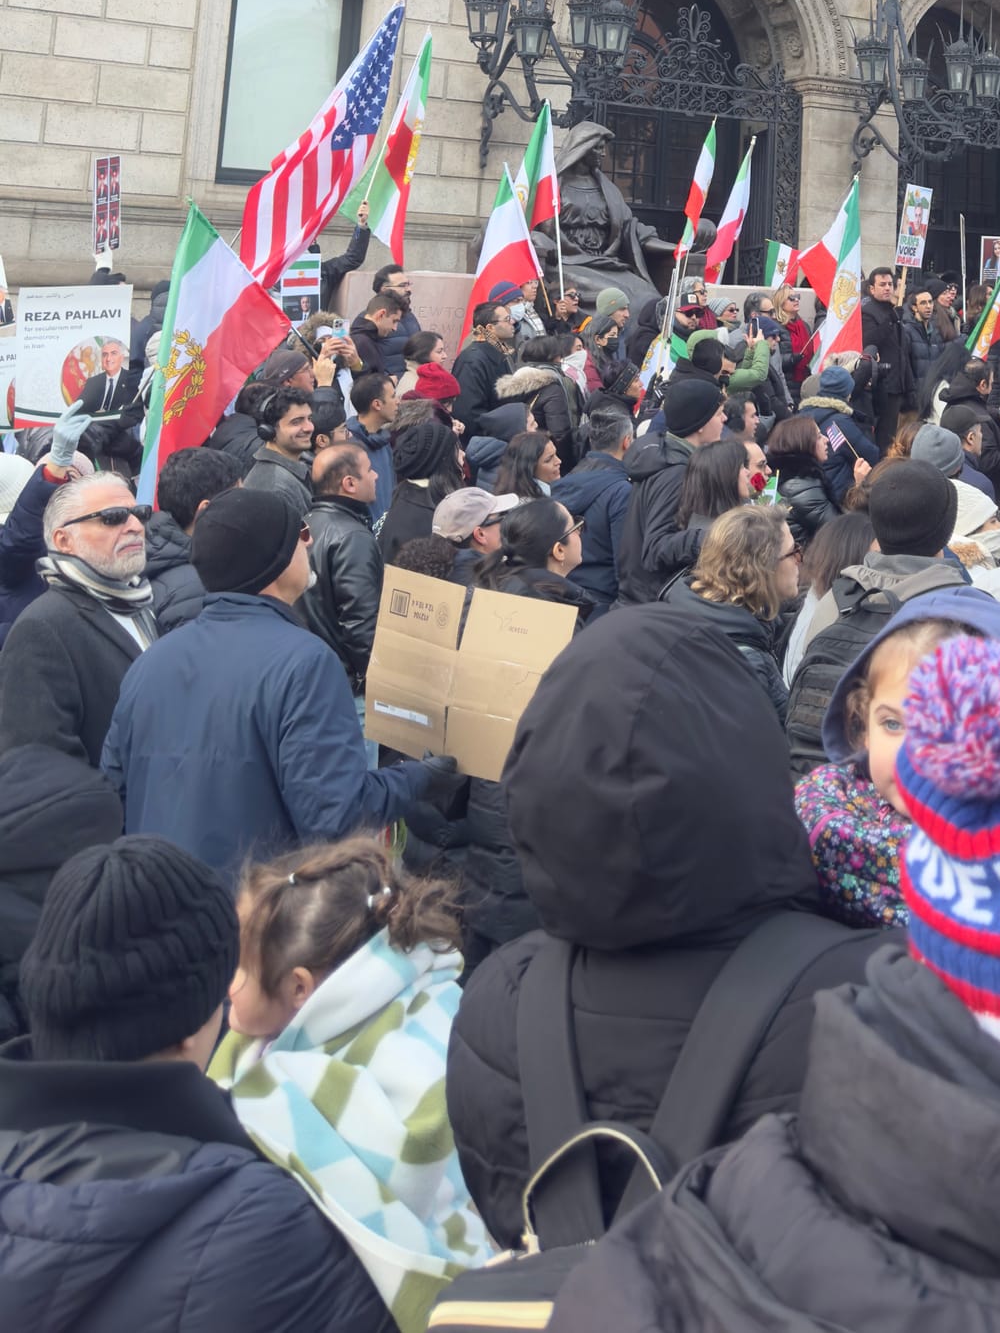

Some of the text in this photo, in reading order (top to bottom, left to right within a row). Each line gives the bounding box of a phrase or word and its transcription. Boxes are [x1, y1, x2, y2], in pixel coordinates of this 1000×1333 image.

[899, 245, 917, 256] VOICE
[24, 308, 121, 322] REZA PAHLAVI
